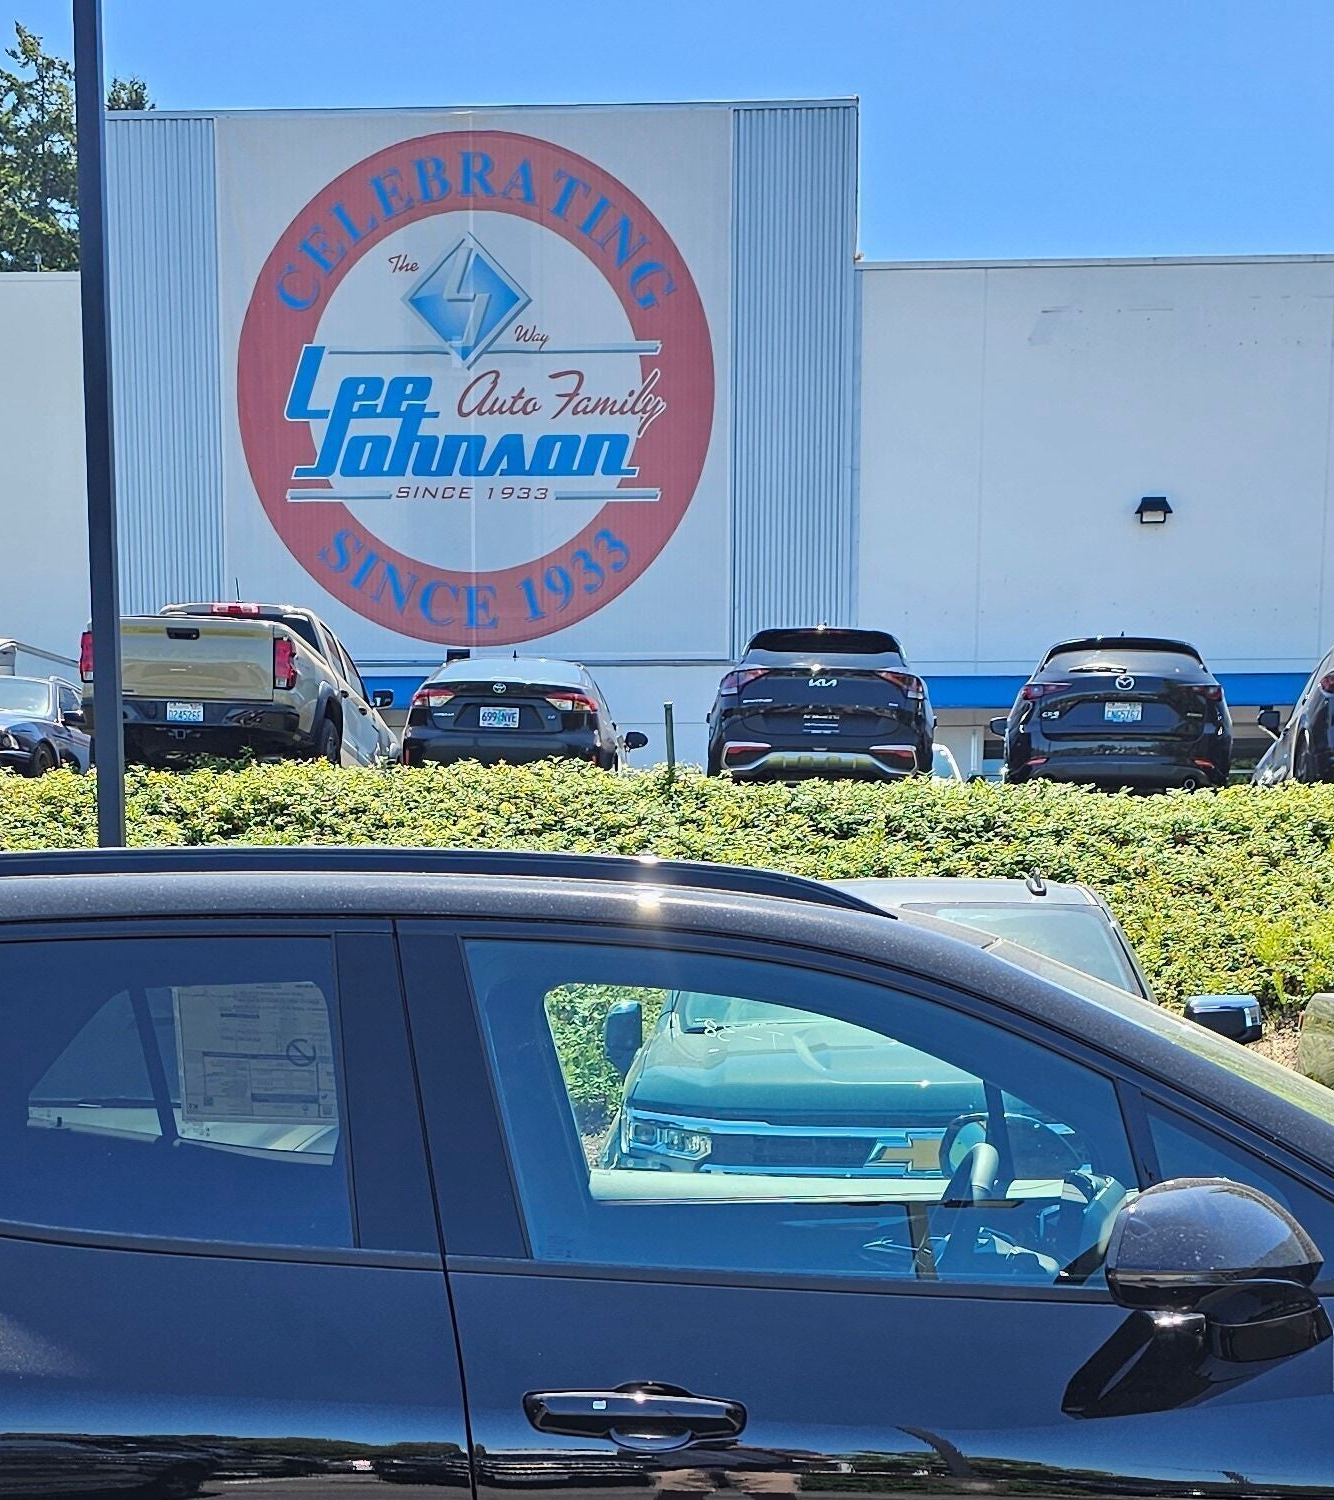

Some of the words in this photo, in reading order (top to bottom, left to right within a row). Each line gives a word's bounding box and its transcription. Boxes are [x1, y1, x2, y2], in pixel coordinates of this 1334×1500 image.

[275, 150, 676, 311] CELEBRATING
[388, 254, 419, 273] The
[514, 325, 549, 351] Way
[285, 344, 440, 420] Lee
[457, 370, 541, 419] Auto
[548, 369, 666, 437] Family
[292, 422, 639, 479] Johnson
[395, 485, 473, 501] SINCE
[487, 486, 550, 501] 1933
[317, 528, 500, 630] SINCE
[517, 527, 631, 622] 1933
